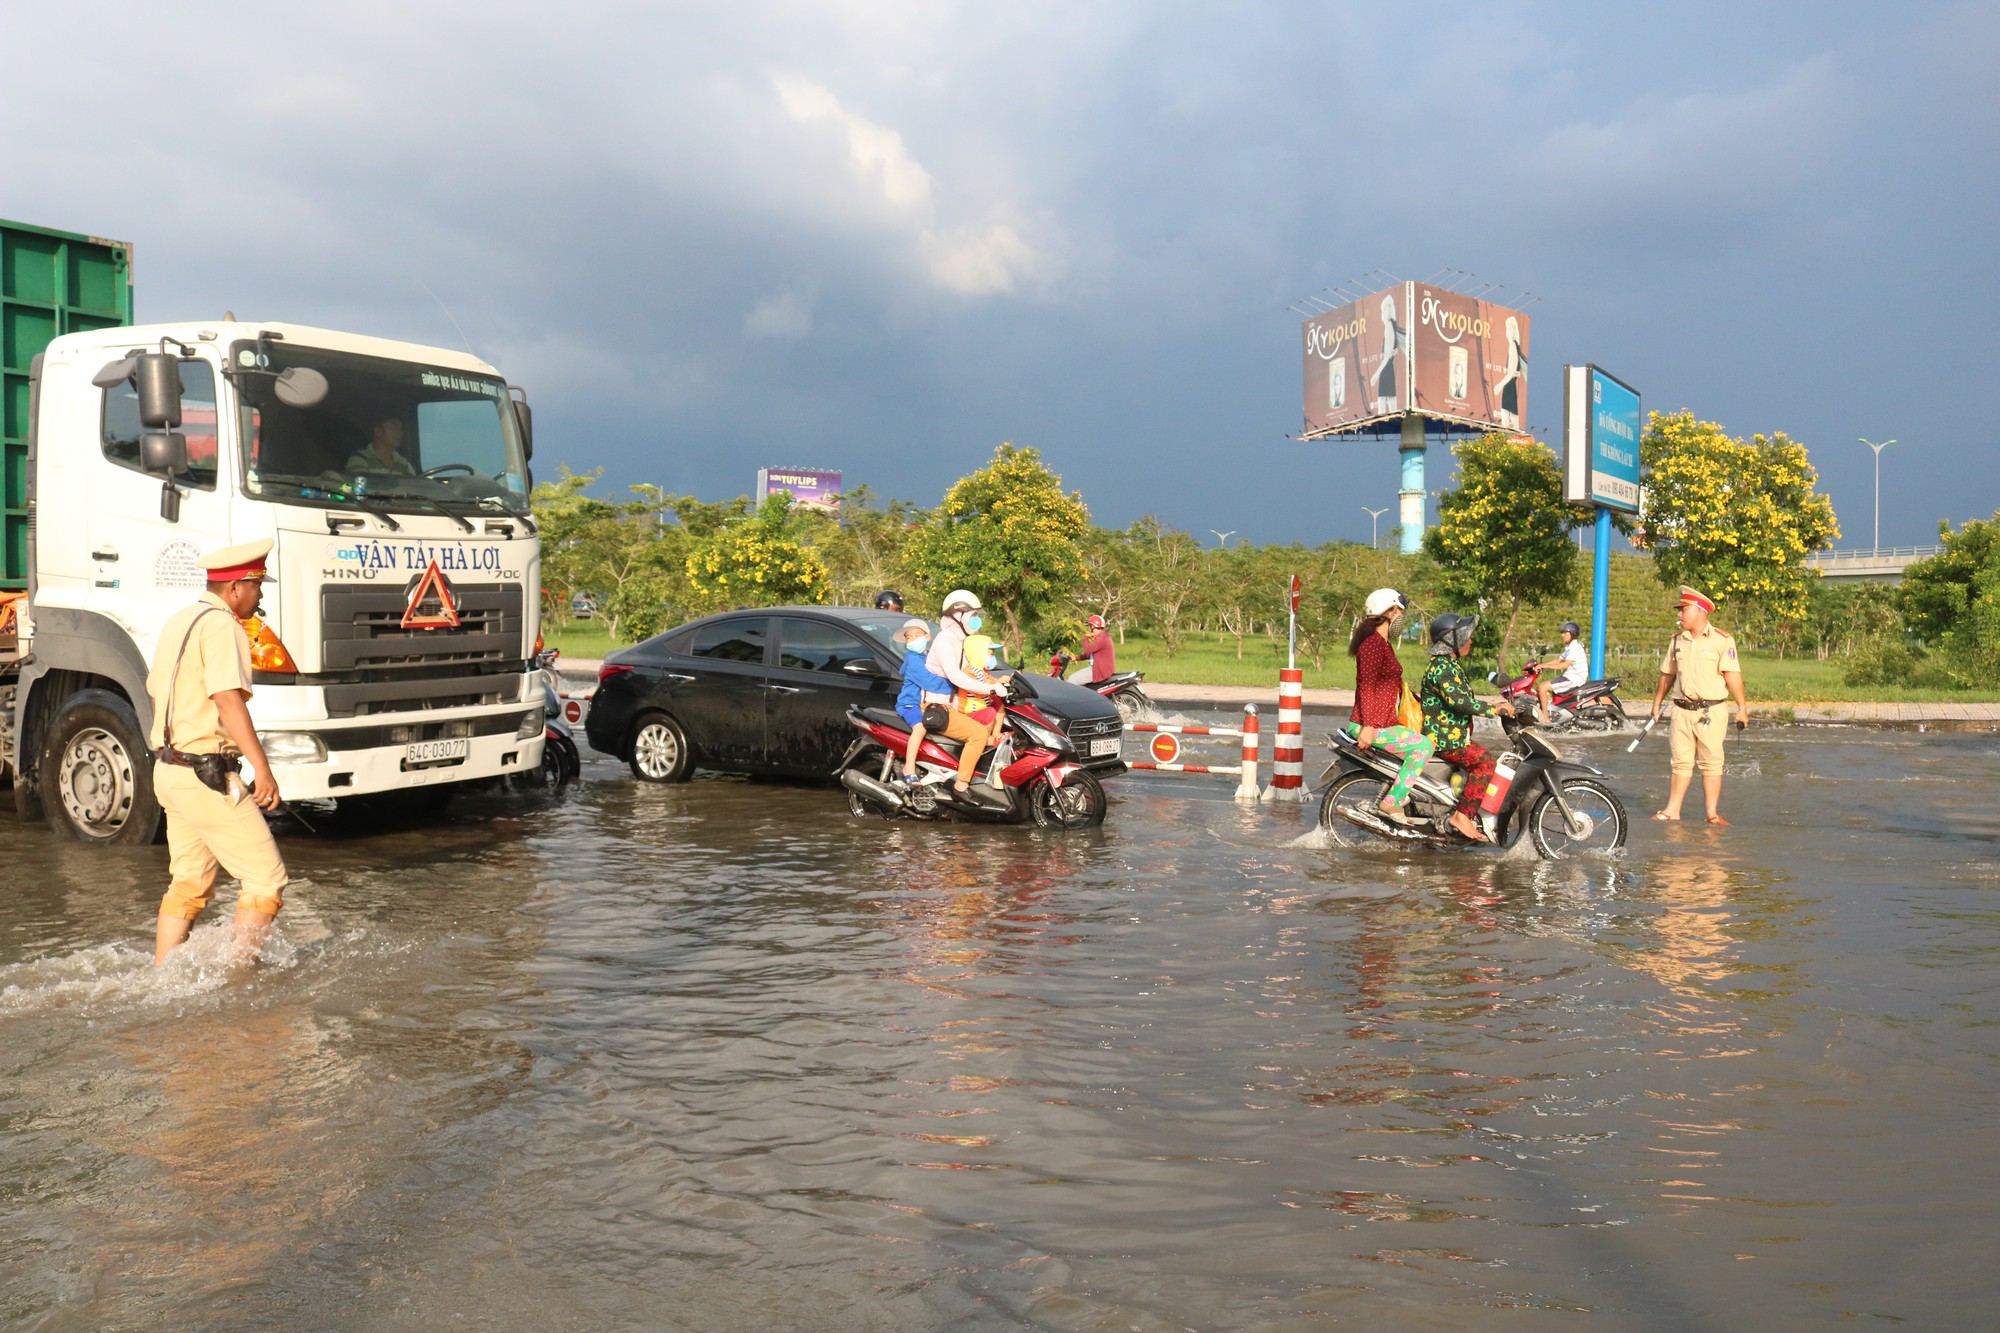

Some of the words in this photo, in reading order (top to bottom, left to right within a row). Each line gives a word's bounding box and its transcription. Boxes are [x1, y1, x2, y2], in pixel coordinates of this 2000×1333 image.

[781, 475, 817, 486] TUYLIPS
[441, 540, 468, 570] HÀ
[322, 569, 376, 579] HINO
